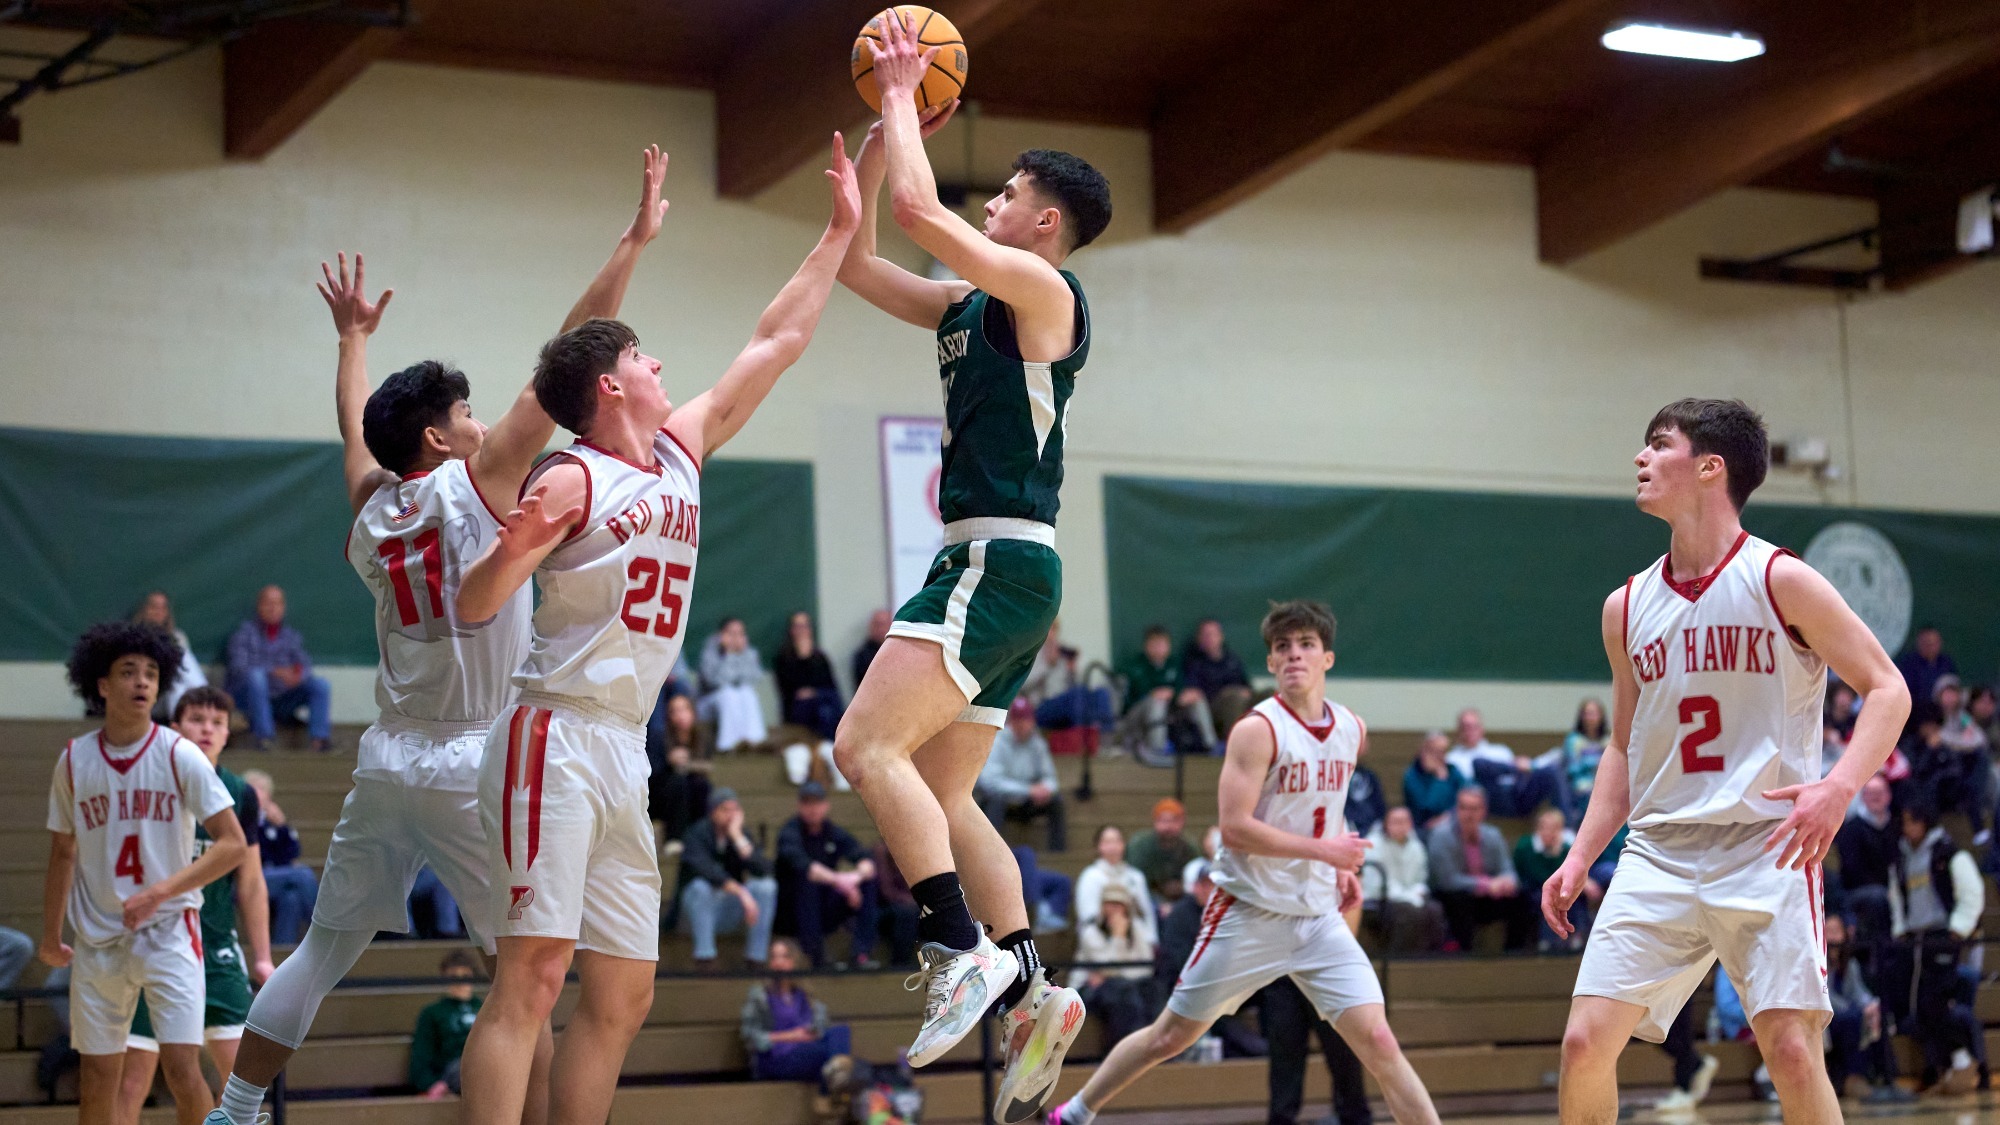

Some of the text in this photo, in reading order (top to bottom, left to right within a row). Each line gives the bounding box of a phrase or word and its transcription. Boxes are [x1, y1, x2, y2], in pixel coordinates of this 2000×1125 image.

[377, 527, 444, 627] 11
[620, 556, 691, 639] 25
[1683, 625, 1777, 675] HAWKS
[1678, 695, 1725, 774] 2
[1276, 761, 1309, 794] RED
[79, 788, 177, 830] RED HAWKS
[1312, 806, 1327, 839] 1
[115, 834, 143, 885] 4
[508, 885, 535, 920] P
